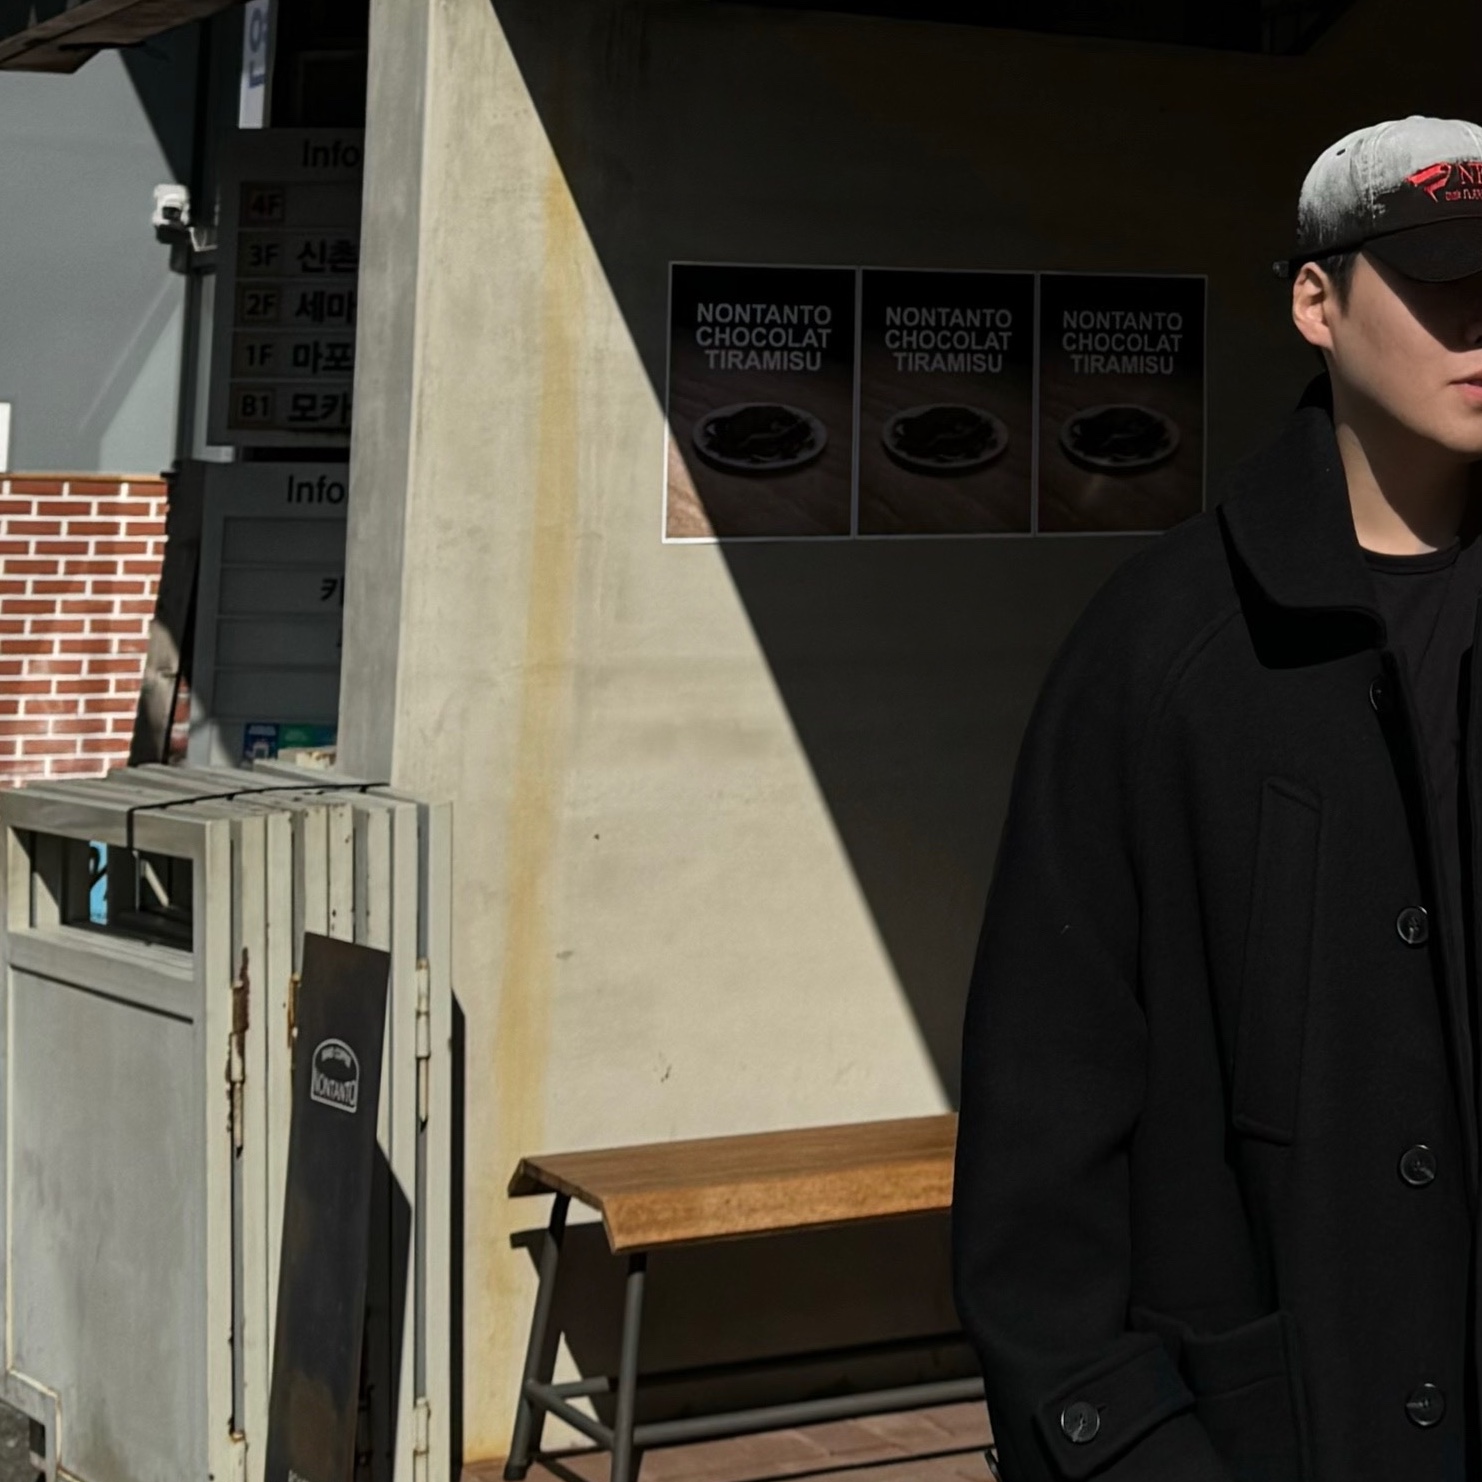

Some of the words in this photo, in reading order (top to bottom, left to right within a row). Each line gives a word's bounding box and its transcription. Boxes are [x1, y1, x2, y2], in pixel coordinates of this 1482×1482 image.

[251, 194, 282, 215] 4F
[249, 244, 279, 266] 3F
[246, 293, 277, 316] 2F
[696, 302, 832, 325] NONTANTO
[884, 306, 1013, 329] NONTANTO
[1062, 310, 1184, 332] NONTANTO
[695, 326, 833, 349] CHOCOLAT
[884, 329, 1013, 351] CHOCOLAT
[1061, 332, 1184, 353] CHOCOLAT
[246, 344, 273, 366] 1F
[704, 349, 822, 371] TIRAMISU
[893, 352, 1004, 374] TIRAMISU
[1069, 354, 1175, 376] TIRAMISU
[242, 394, 268, 417] B1
[287, 474, 346, 504] Info
